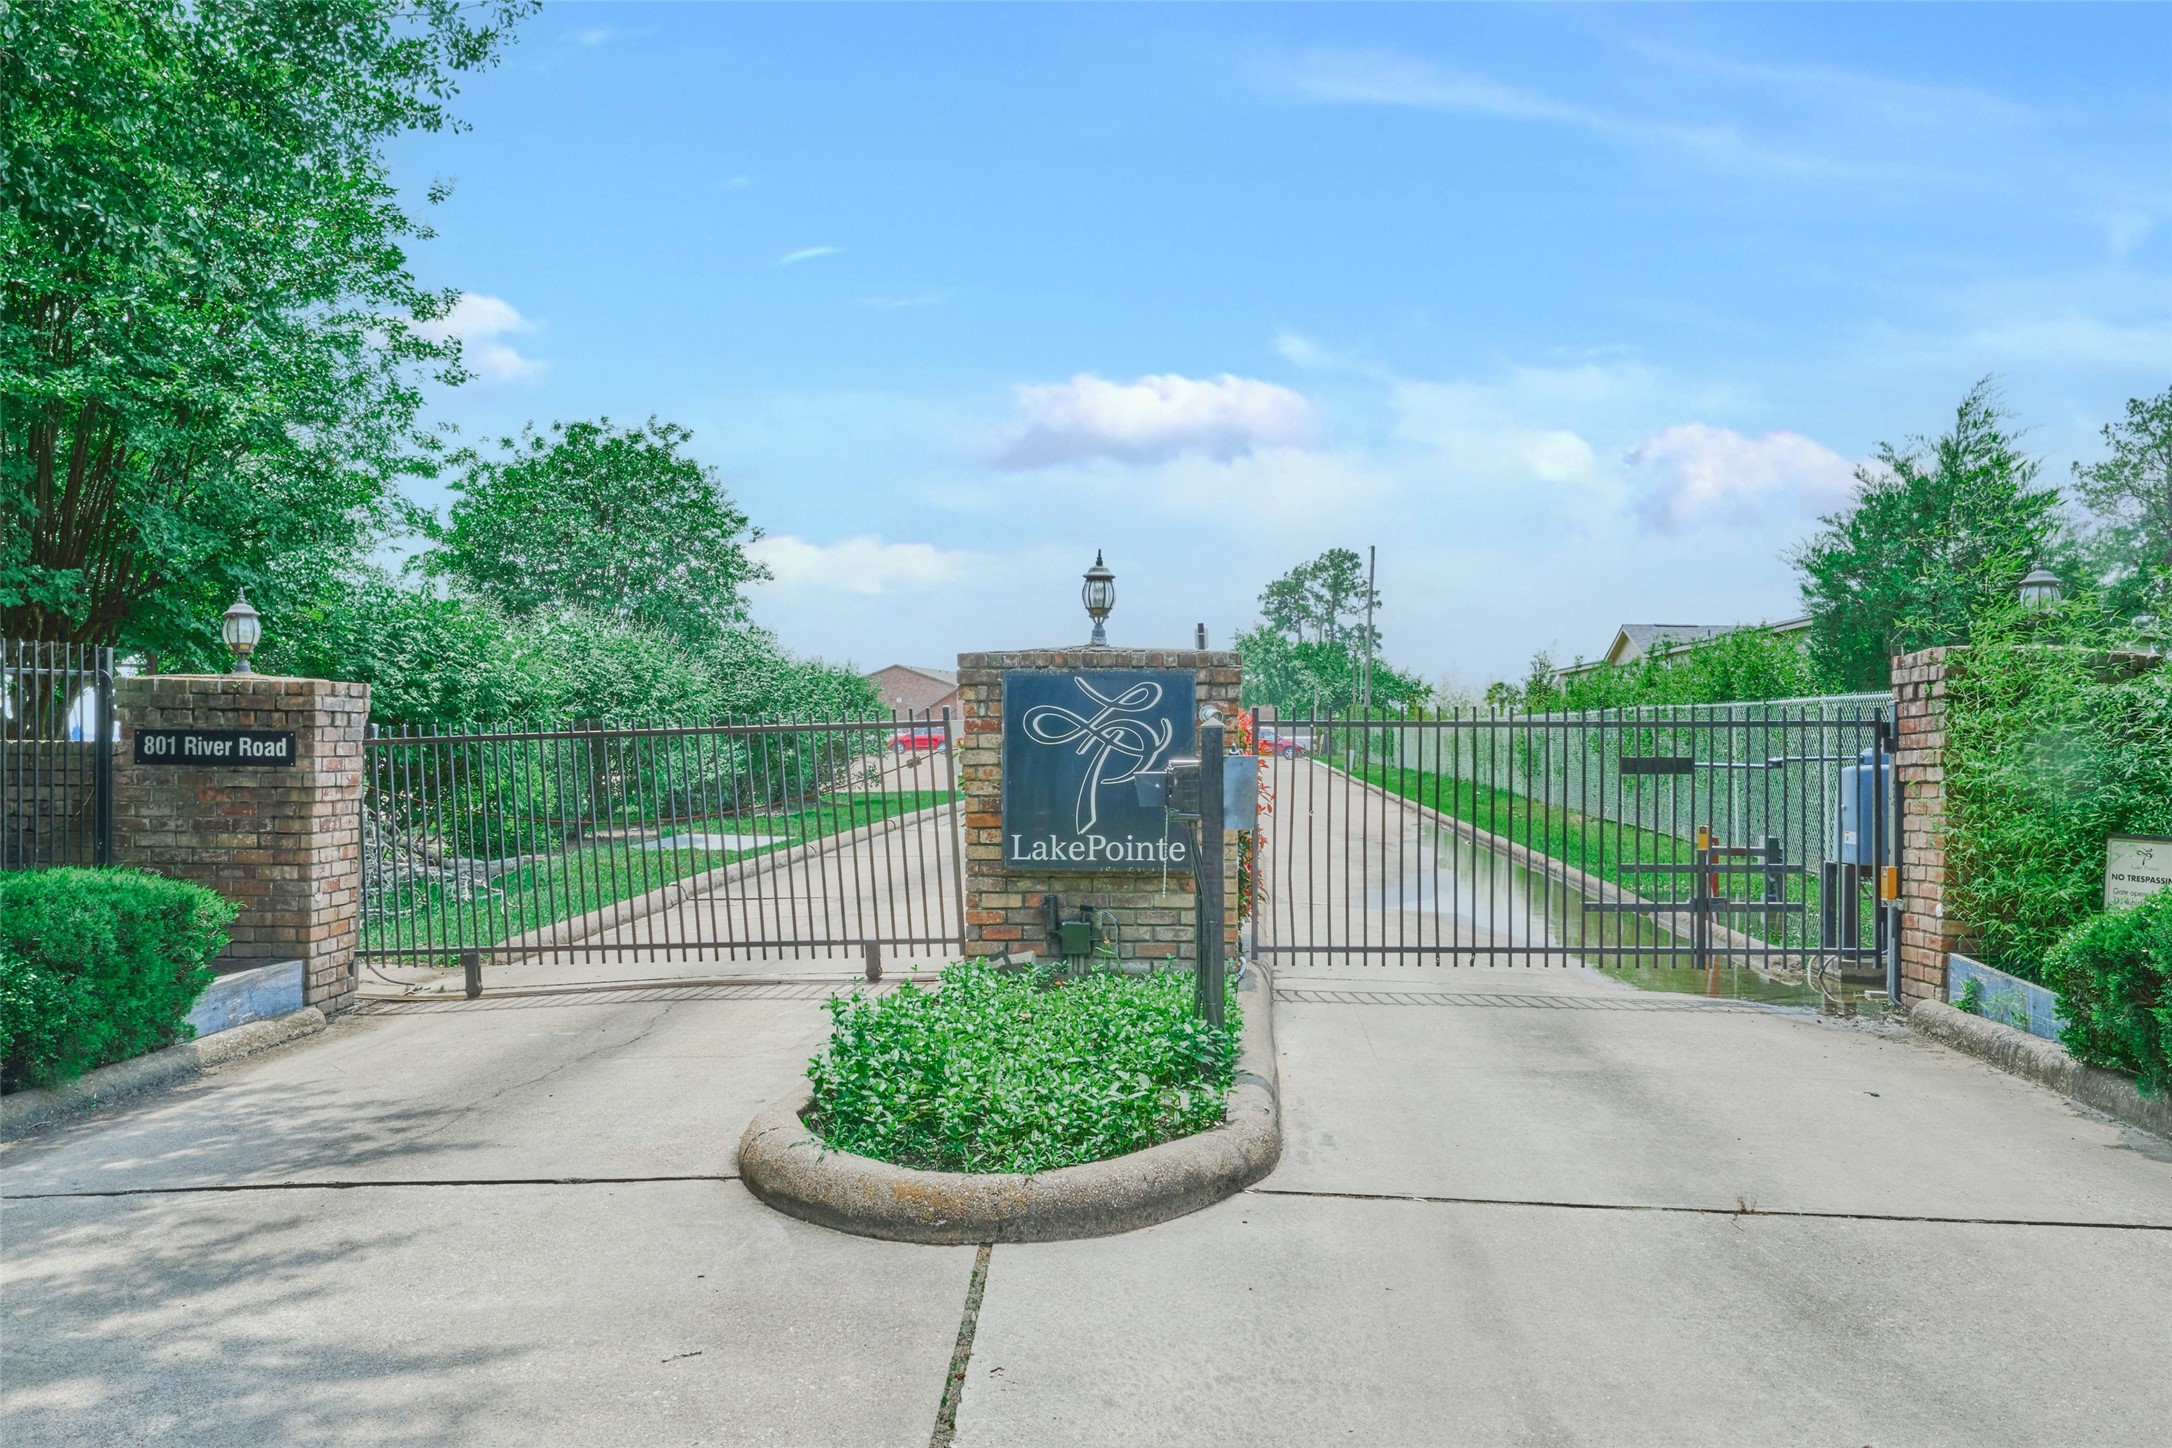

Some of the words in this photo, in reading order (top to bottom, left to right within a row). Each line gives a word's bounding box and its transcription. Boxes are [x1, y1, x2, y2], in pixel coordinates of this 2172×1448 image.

[143, 735, 176, 755] 801
[184, 736, 233, 756] River
[239, 737, 287, 757] Road
[1010, 834, 1186, 862] LakePointe
[2113, 887, 2128, 895] Gate
